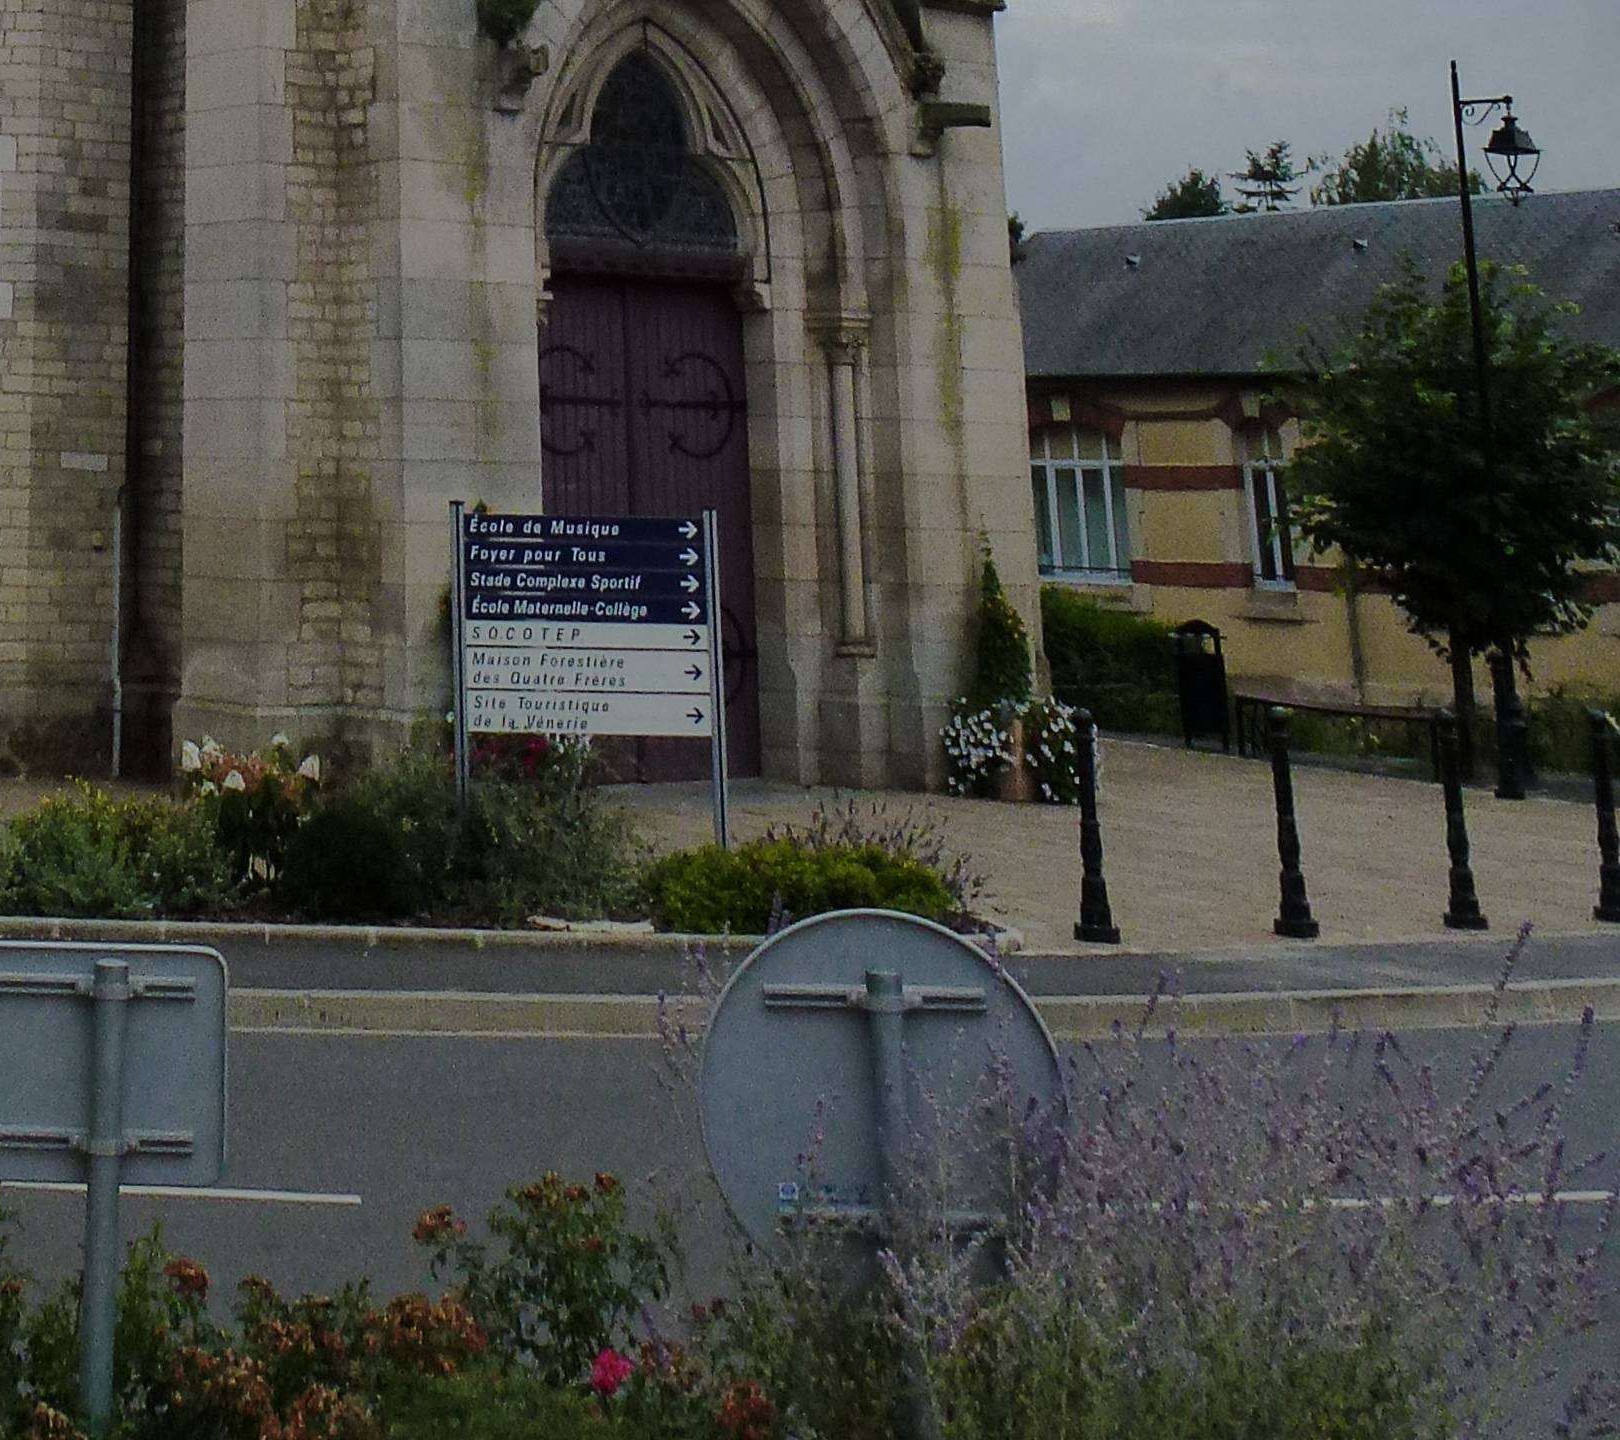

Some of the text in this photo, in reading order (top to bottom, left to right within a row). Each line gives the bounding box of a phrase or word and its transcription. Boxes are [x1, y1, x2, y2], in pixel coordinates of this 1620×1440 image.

[469, 514, 620, 539] École de Musique
[470, 545, 606, 564] Foyer pour Tous
[470, 572, 642, 591] Stade Complexe Sportif
[472, 594, 510, 614] École
[472, 652, 625, 669] Maison Forestière
[473, 671, 625, 687] des Quatre Frères
[474, 695, 610, 714] Site Touristique
[474, 714, 588, 729] de la Vénerie
